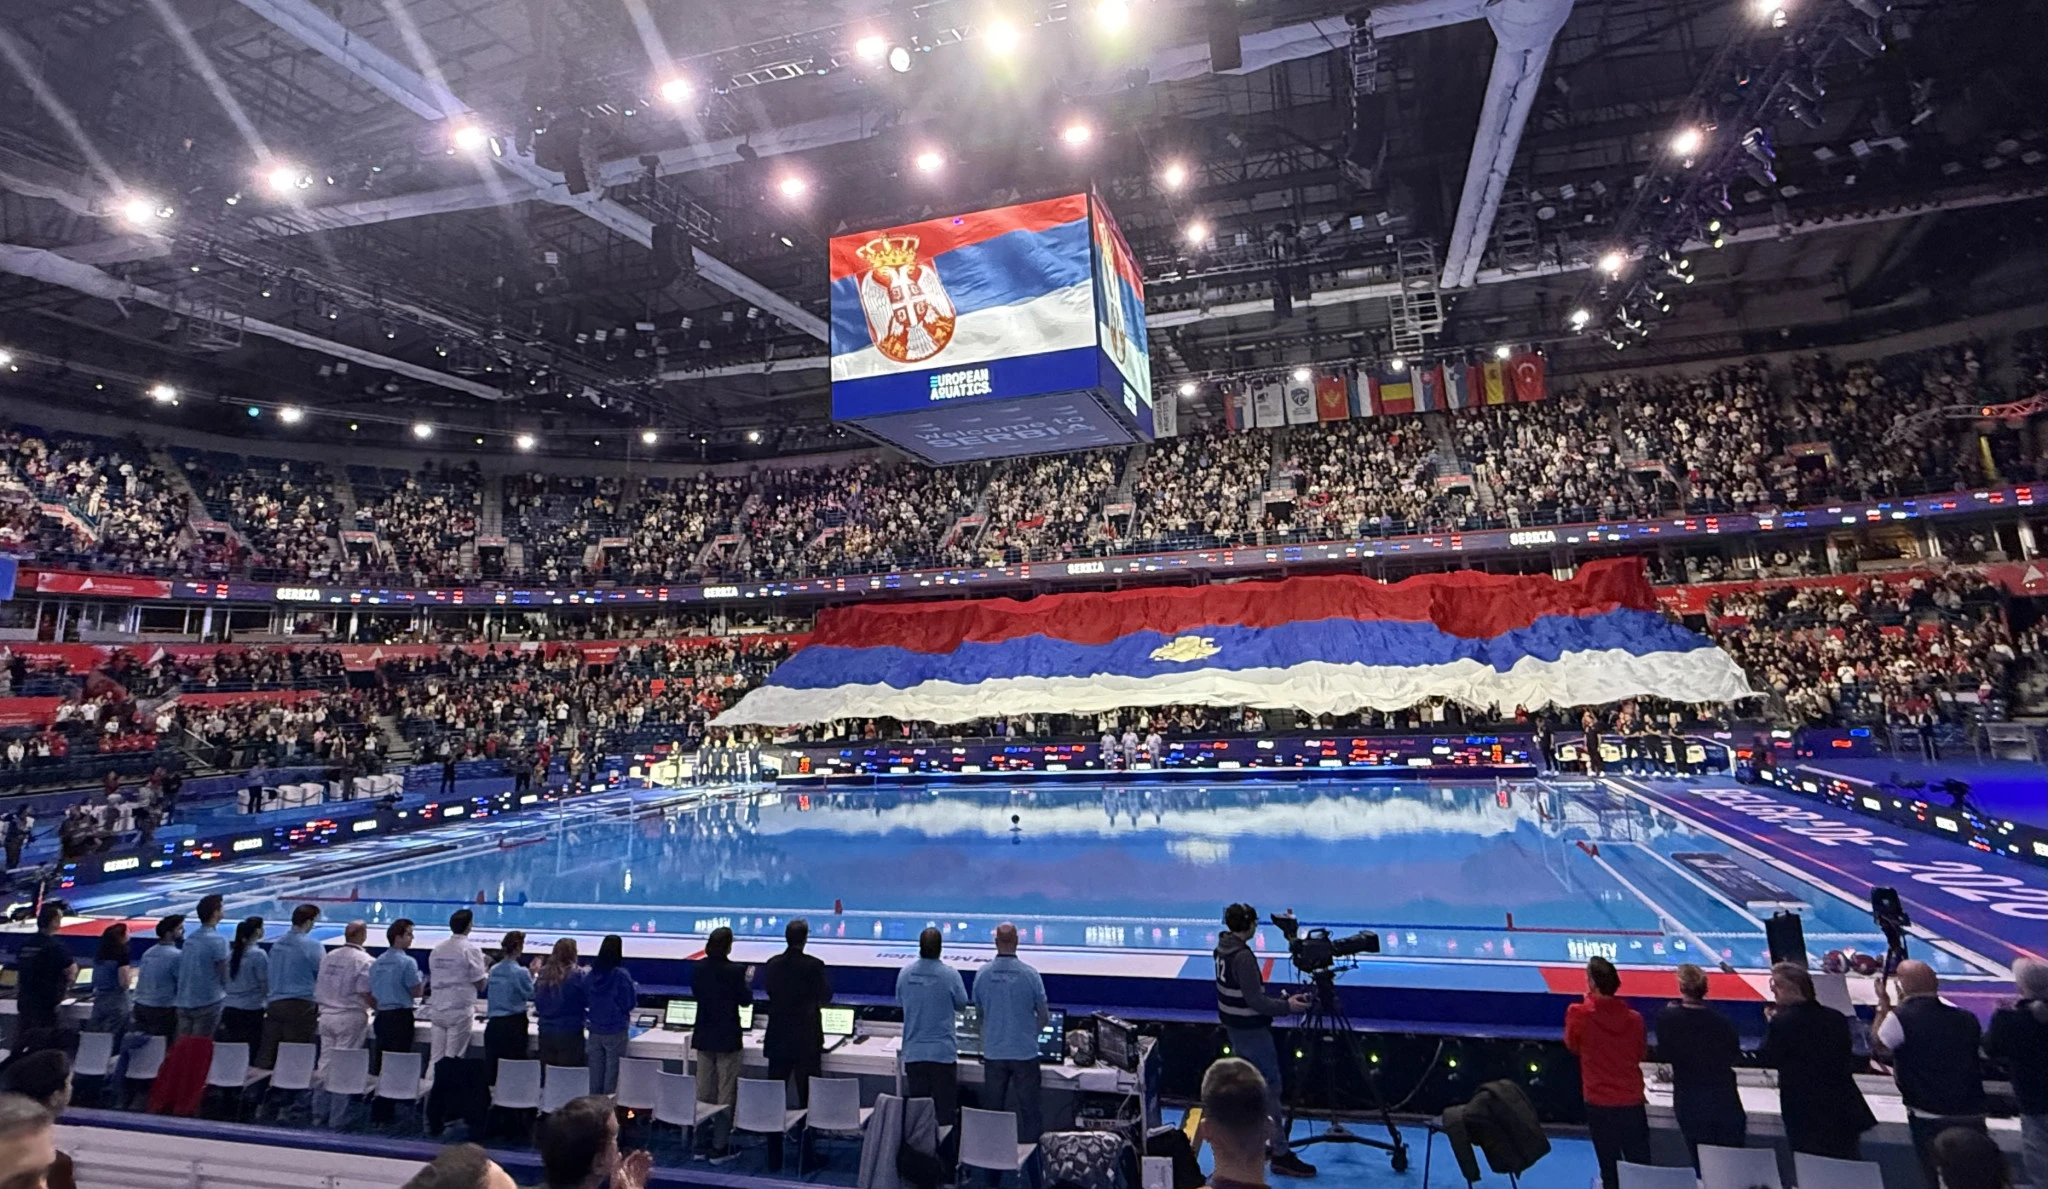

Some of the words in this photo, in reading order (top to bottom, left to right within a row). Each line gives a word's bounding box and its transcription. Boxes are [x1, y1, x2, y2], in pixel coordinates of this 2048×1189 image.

[930, 368, 989, 387] EUROPEAN
[915, 422, 1047, 440] Welcome
[1053, 415, 1085, 425] to
[926, 422, 1097, 448] SERBIA
[1510, 530, 1557, 545] SERBIA
[1067, 561, 1105, 574] SERBIA
[276, 587, 320, 601] SERBIA
[1688, 789, 1908, 846] BELGRADE
